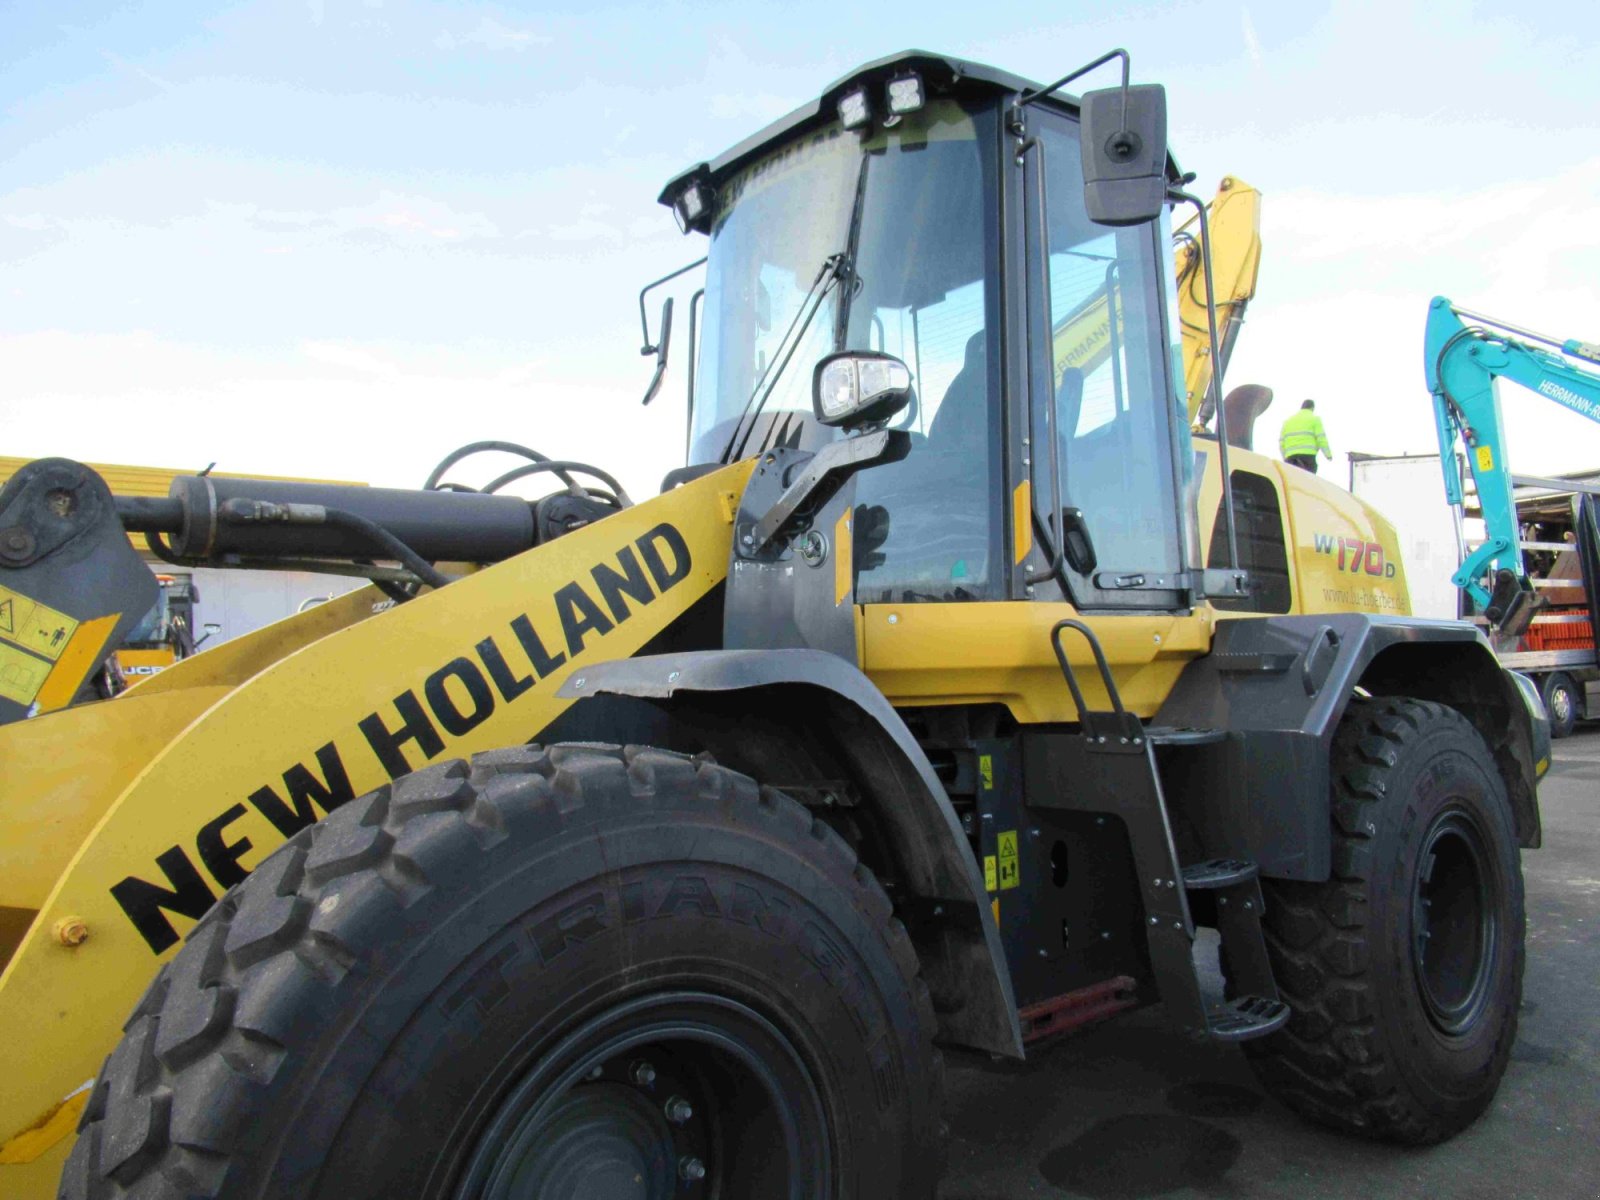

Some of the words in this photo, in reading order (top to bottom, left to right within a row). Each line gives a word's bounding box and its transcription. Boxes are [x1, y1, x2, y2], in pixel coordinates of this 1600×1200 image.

[110, 741, 356, 955] NEW
[357, 520, 693, 780] HOLLAND
[439, 874, 903, 1112] TRIANGLE
